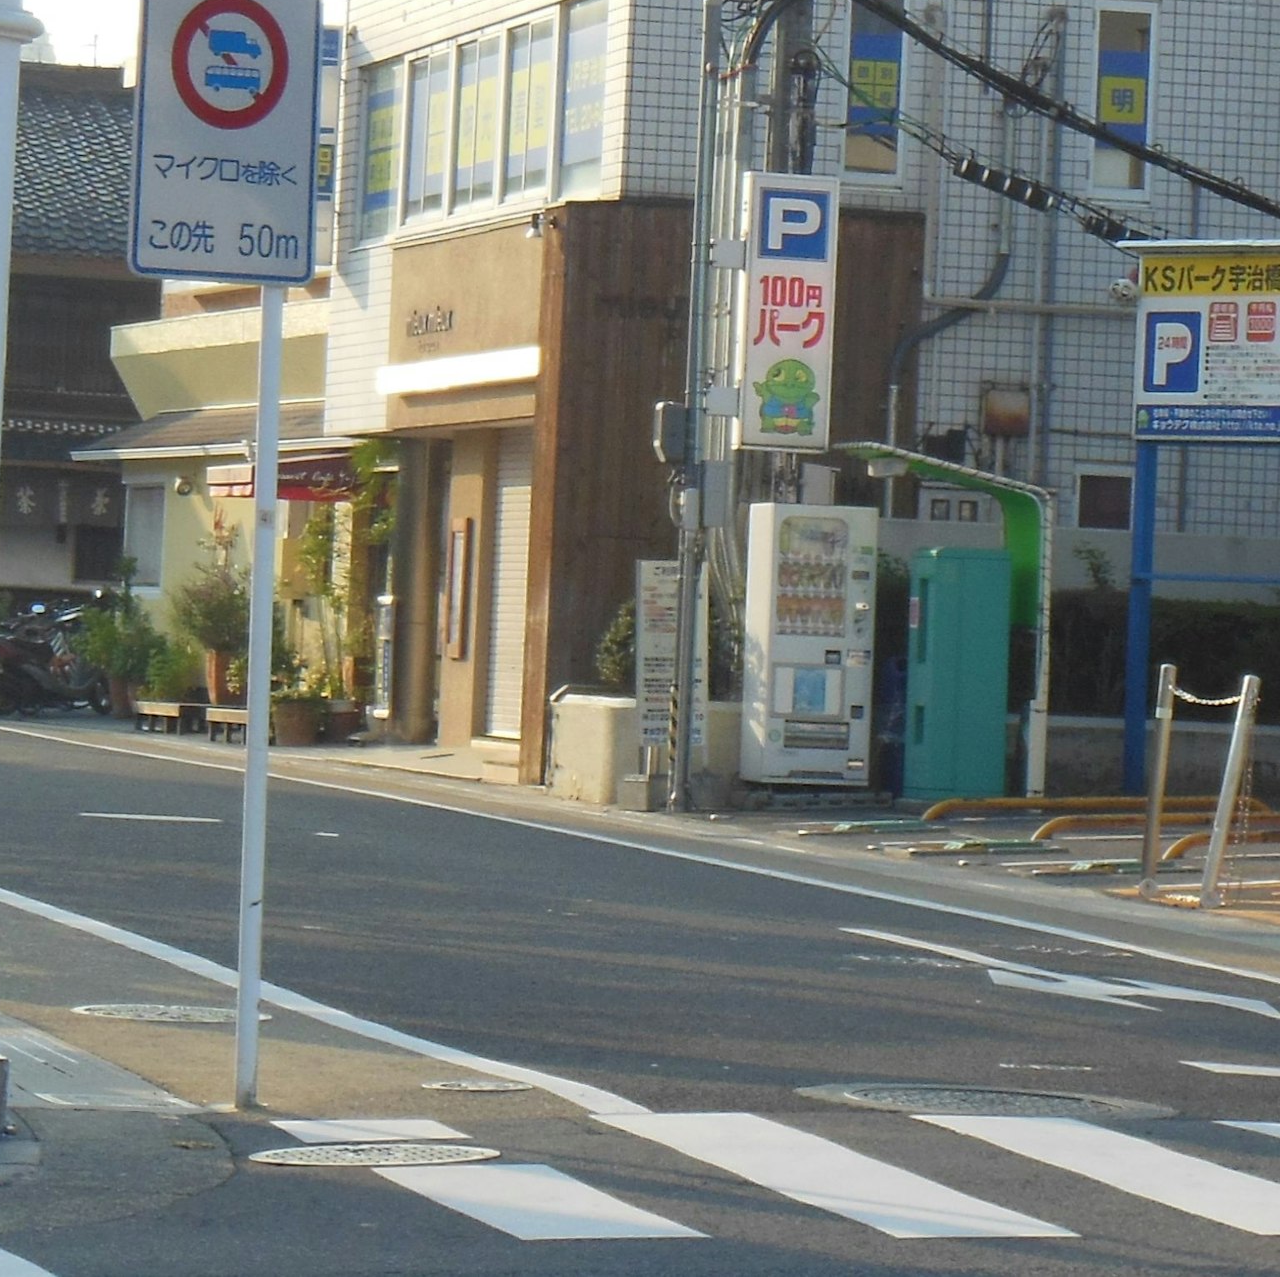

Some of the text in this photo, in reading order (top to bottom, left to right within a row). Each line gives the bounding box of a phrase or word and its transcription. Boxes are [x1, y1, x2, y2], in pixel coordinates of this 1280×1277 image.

[153, 154, 298, 186] マイクロを除く
[148, 219, 298, 260] この先 50m
[767, 197, 822, 250] P
[759, 275, 823, 308] 100円
[753, 308, 826, 349] パーク
